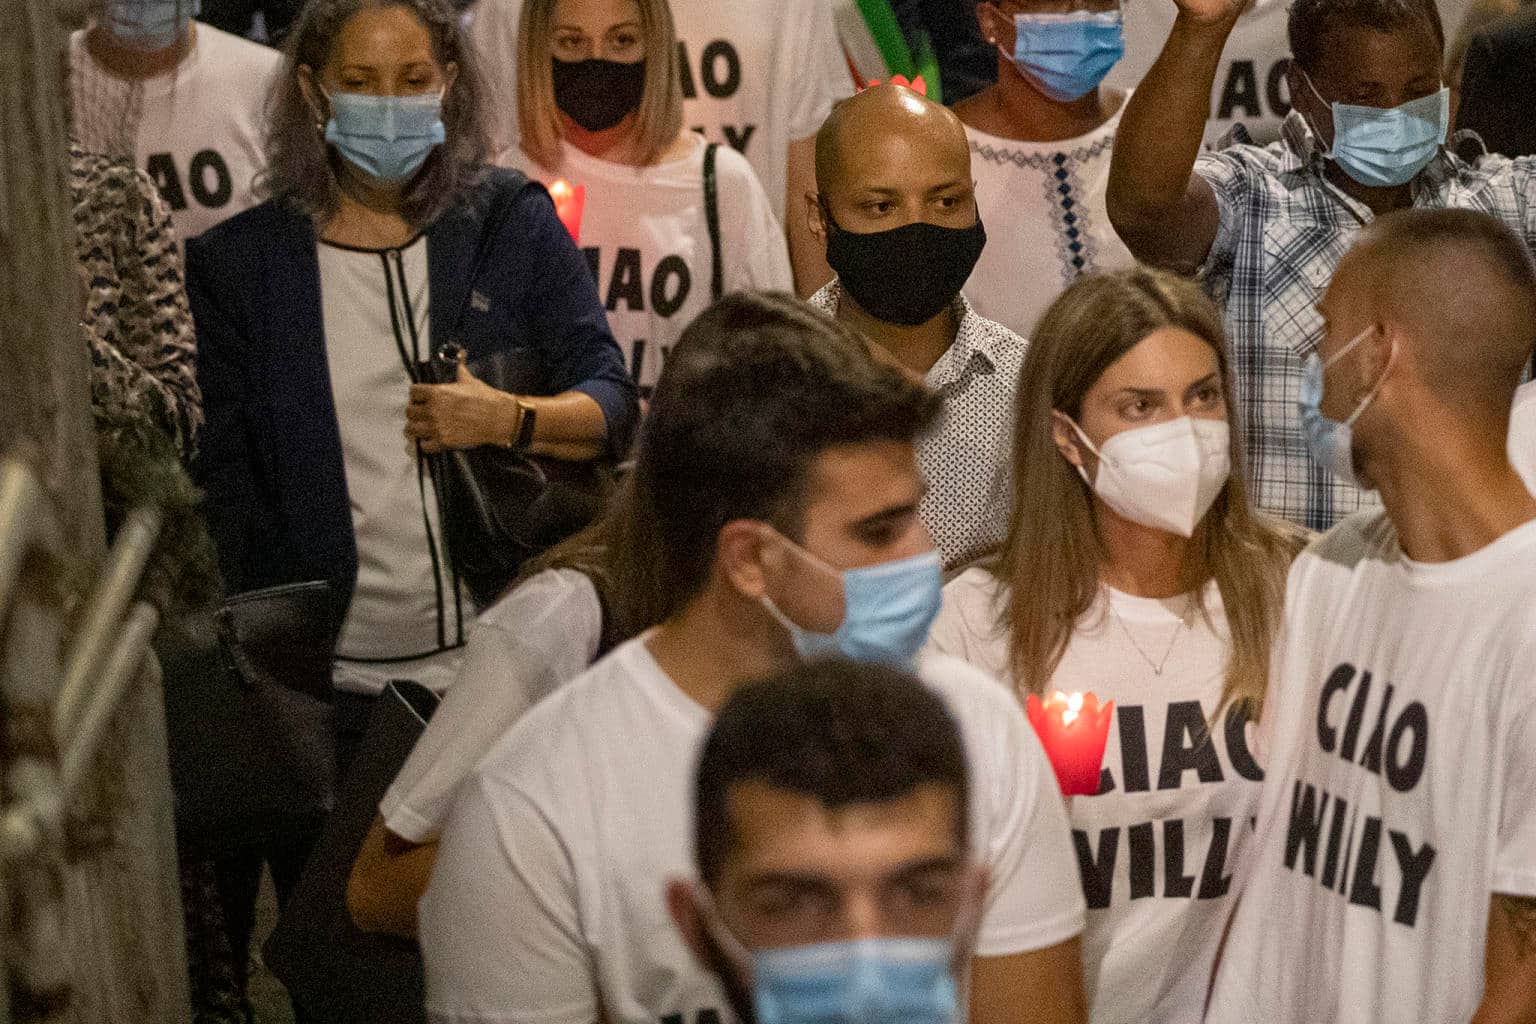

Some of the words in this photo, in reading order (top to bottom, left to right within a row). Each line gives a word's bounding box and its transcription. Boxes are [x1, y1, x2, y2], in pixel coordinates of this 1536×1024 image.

[147, 149, 233, 210] AO
[1316, 661, 1429, 794] CIAO
[1071, 817, 1257, 910] WILL
[1283, 779, 1438, 928] WILY
